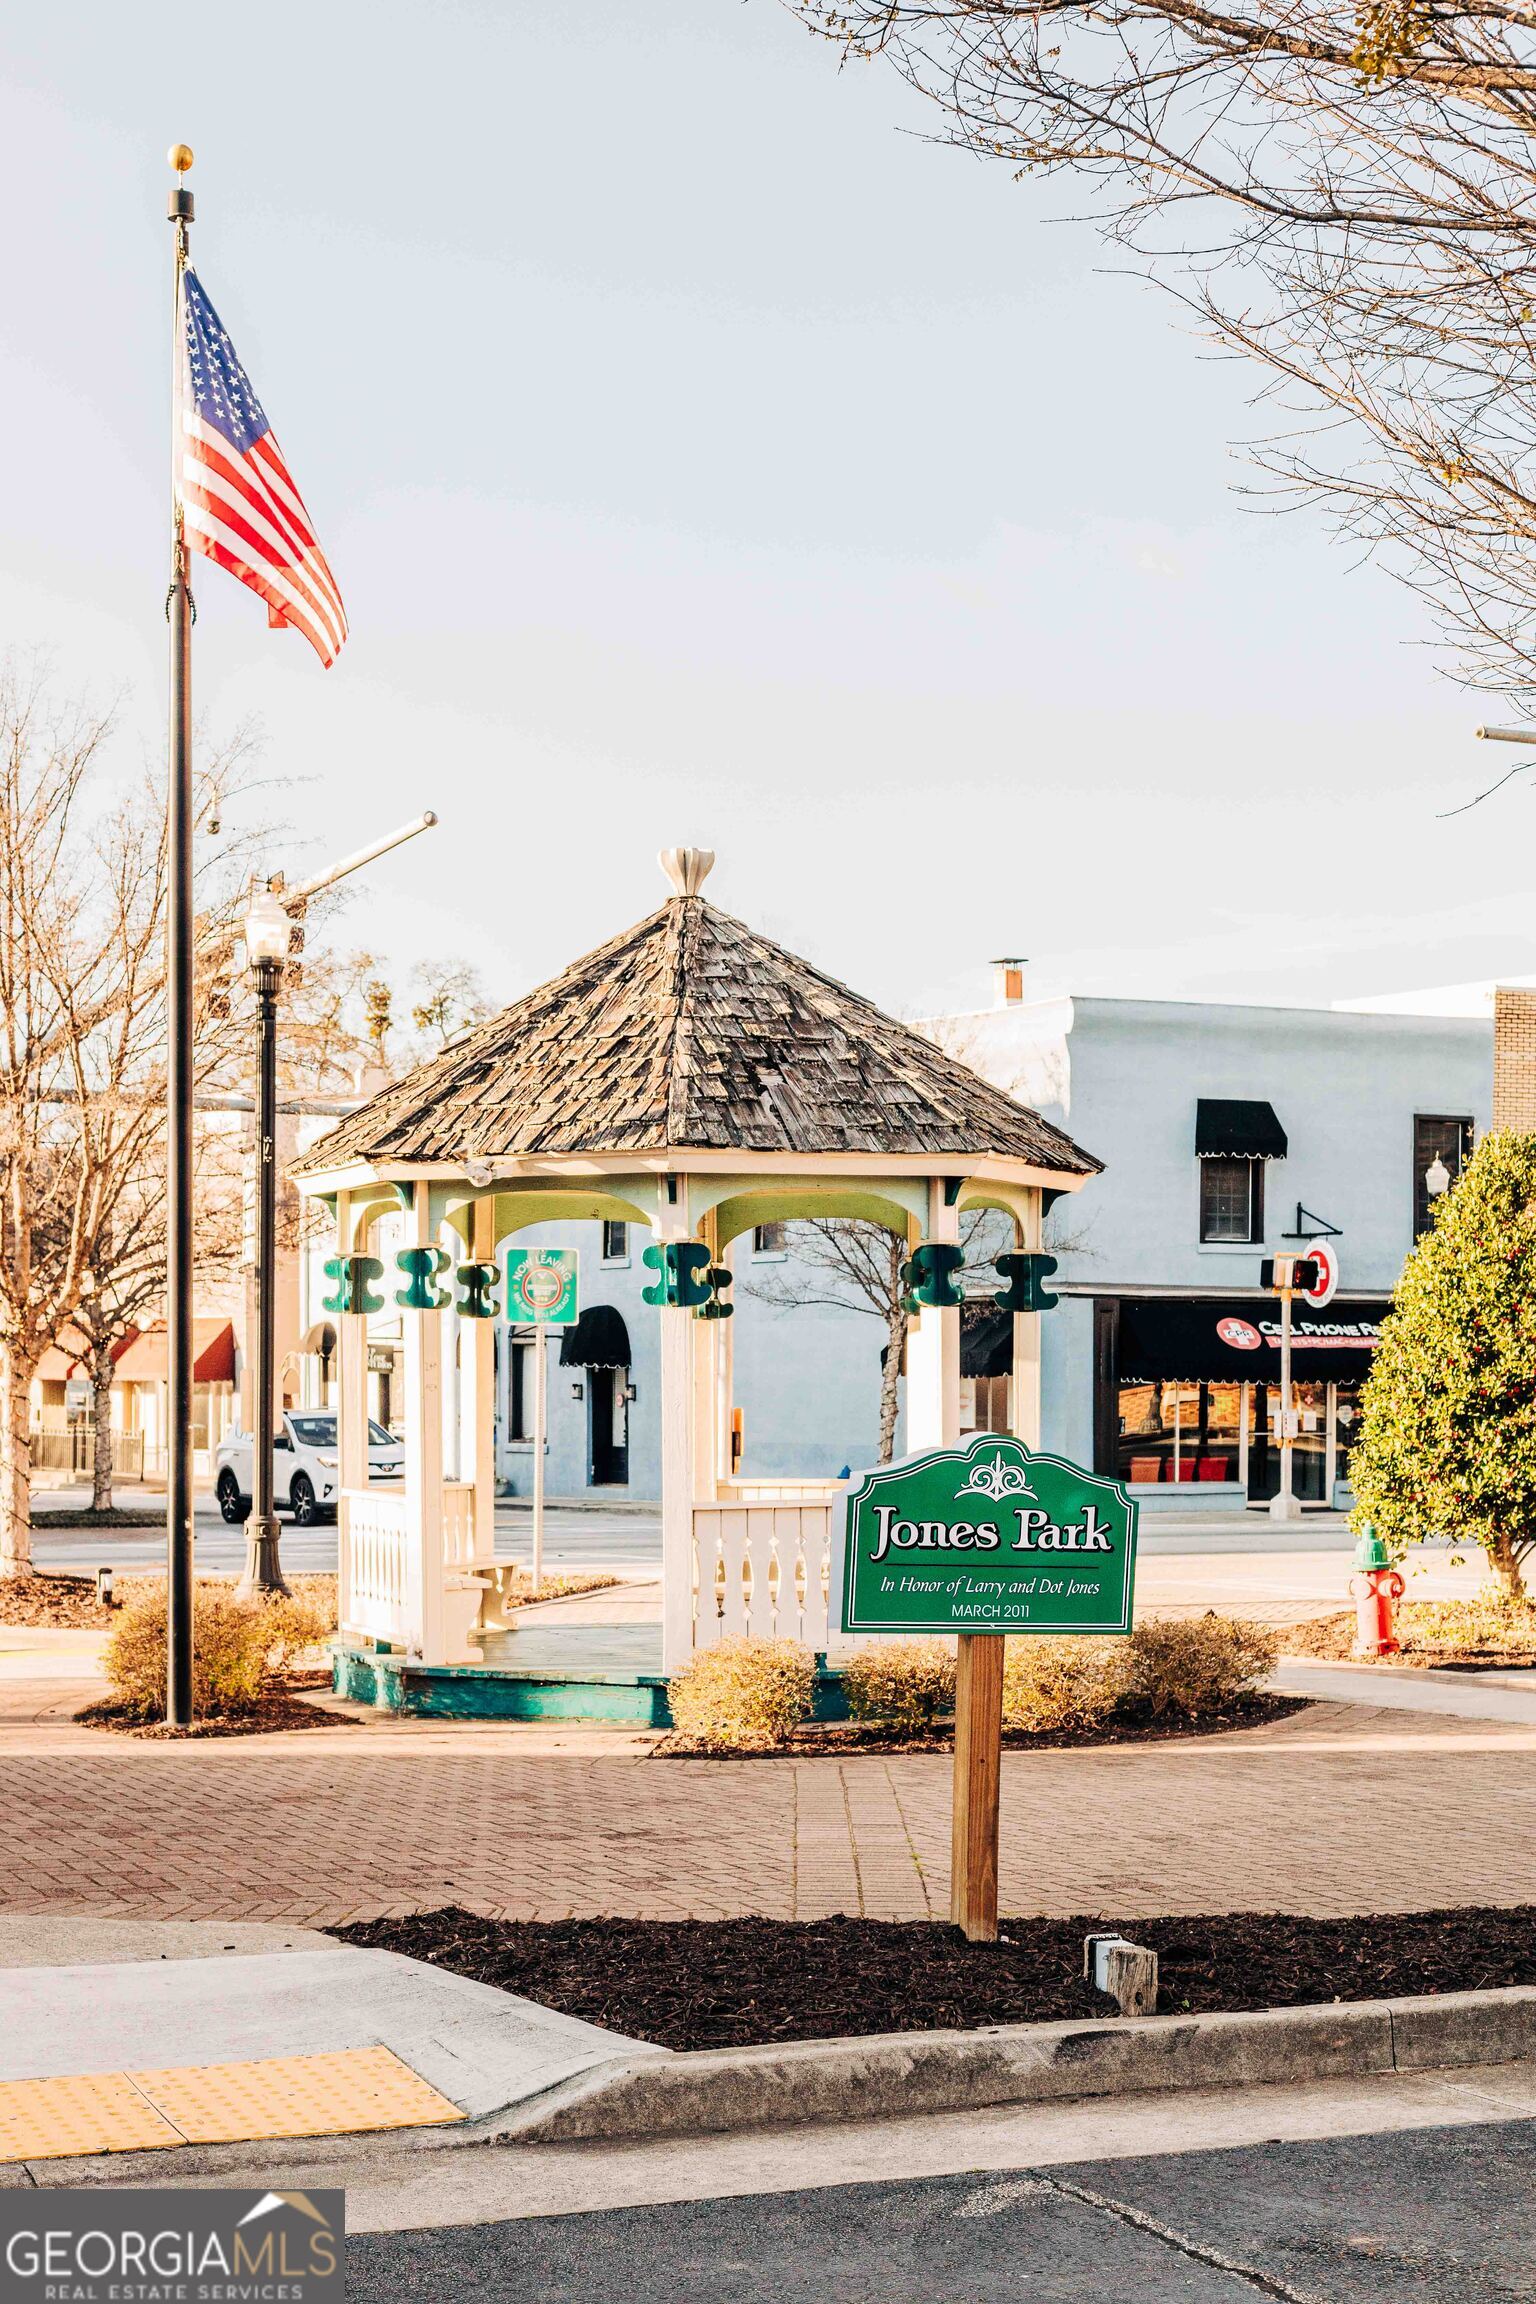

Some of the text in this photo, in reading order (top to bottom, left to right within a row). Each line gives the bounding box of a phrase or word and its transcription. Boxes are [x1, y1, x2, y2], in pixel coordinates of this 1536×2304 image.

[512, 1254, 572, 1282] NOW LEAVING
[1258, 1321, 1303, 1335] CEL
[1300, 1322, 1361, 1337] PHONE
[869, 1505, 1113, 1561] Jones Park
[881, 1575, 1100, 1599] In Honor of Larry and Dot Jones
[951, 1604, 1030, 1618] MARCH 2011
